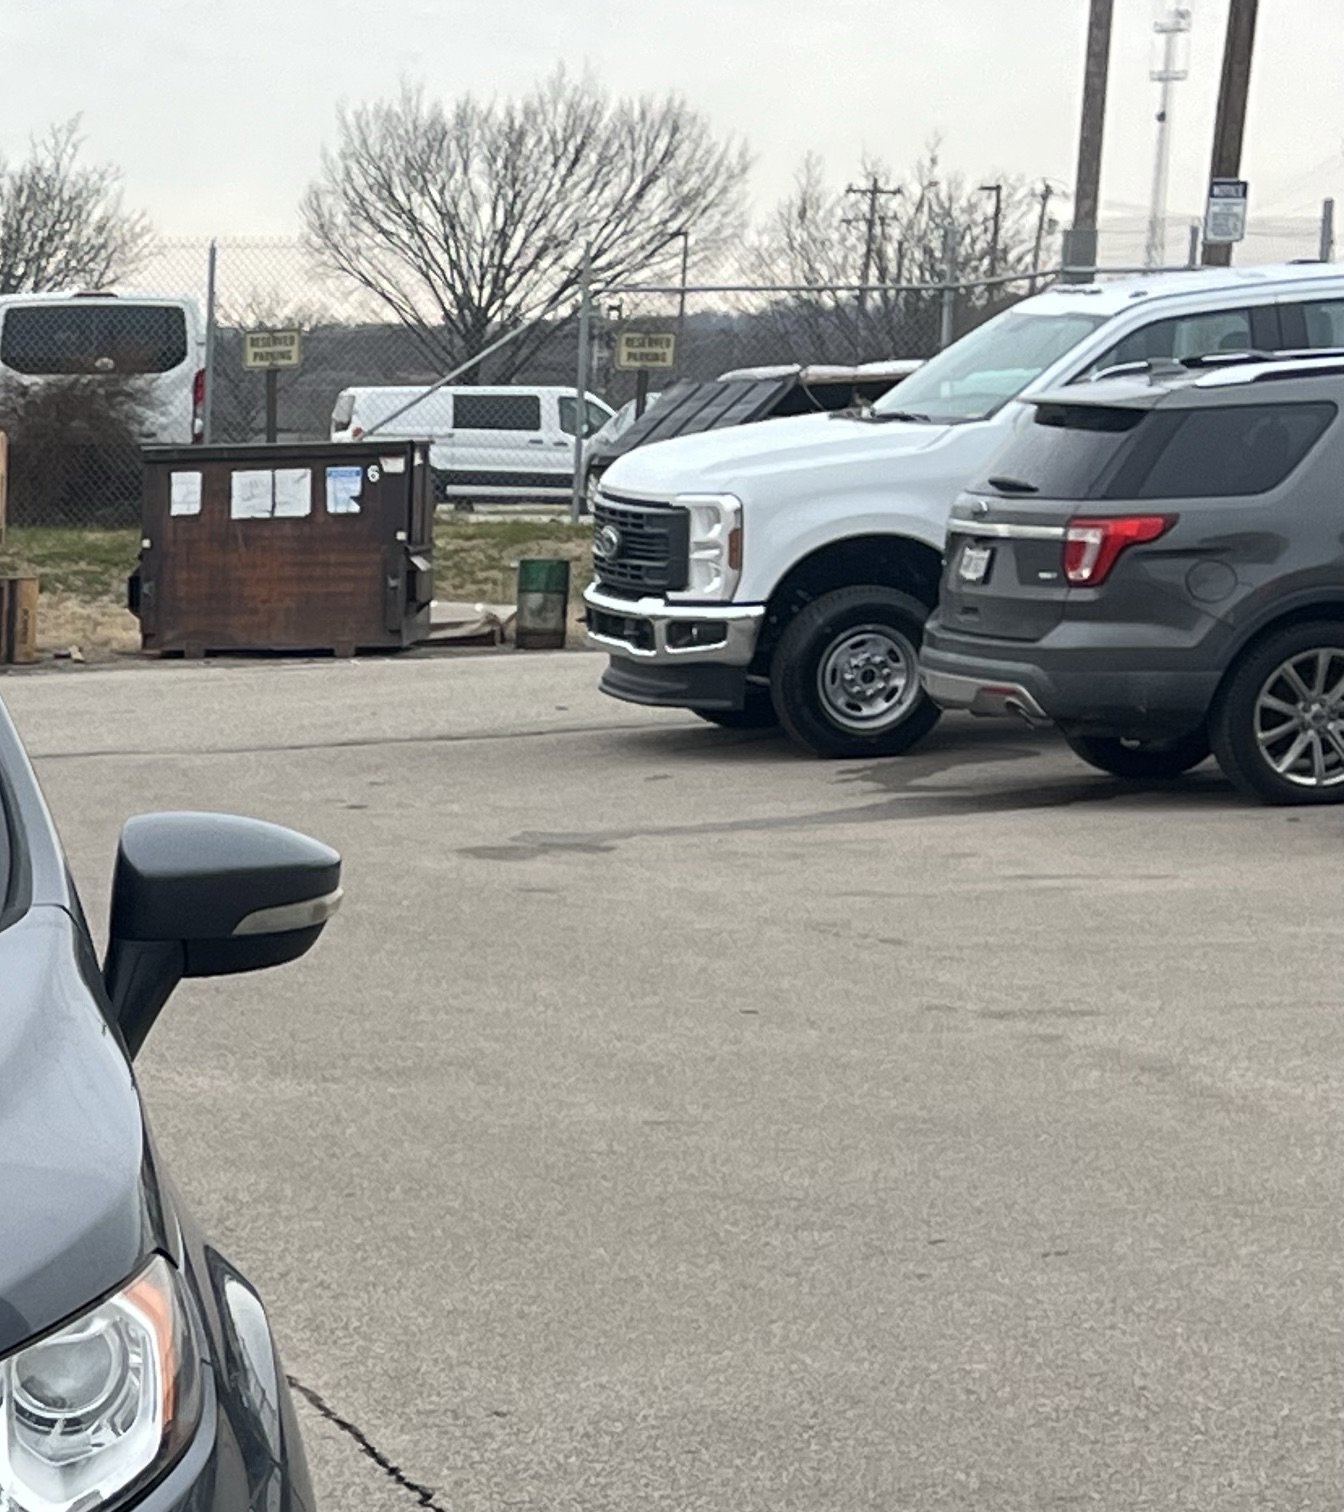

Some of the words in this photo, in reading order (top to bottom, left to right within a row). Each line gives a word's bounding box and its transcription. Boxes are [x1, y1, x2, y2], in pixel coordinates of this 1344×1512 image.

[250, 335, 295, 348] RESERVED
[625, 336, 672, 349] RESERVED
[252, 350, 292, 362] PARKING
[627, 351, 667, 363] PARKING
